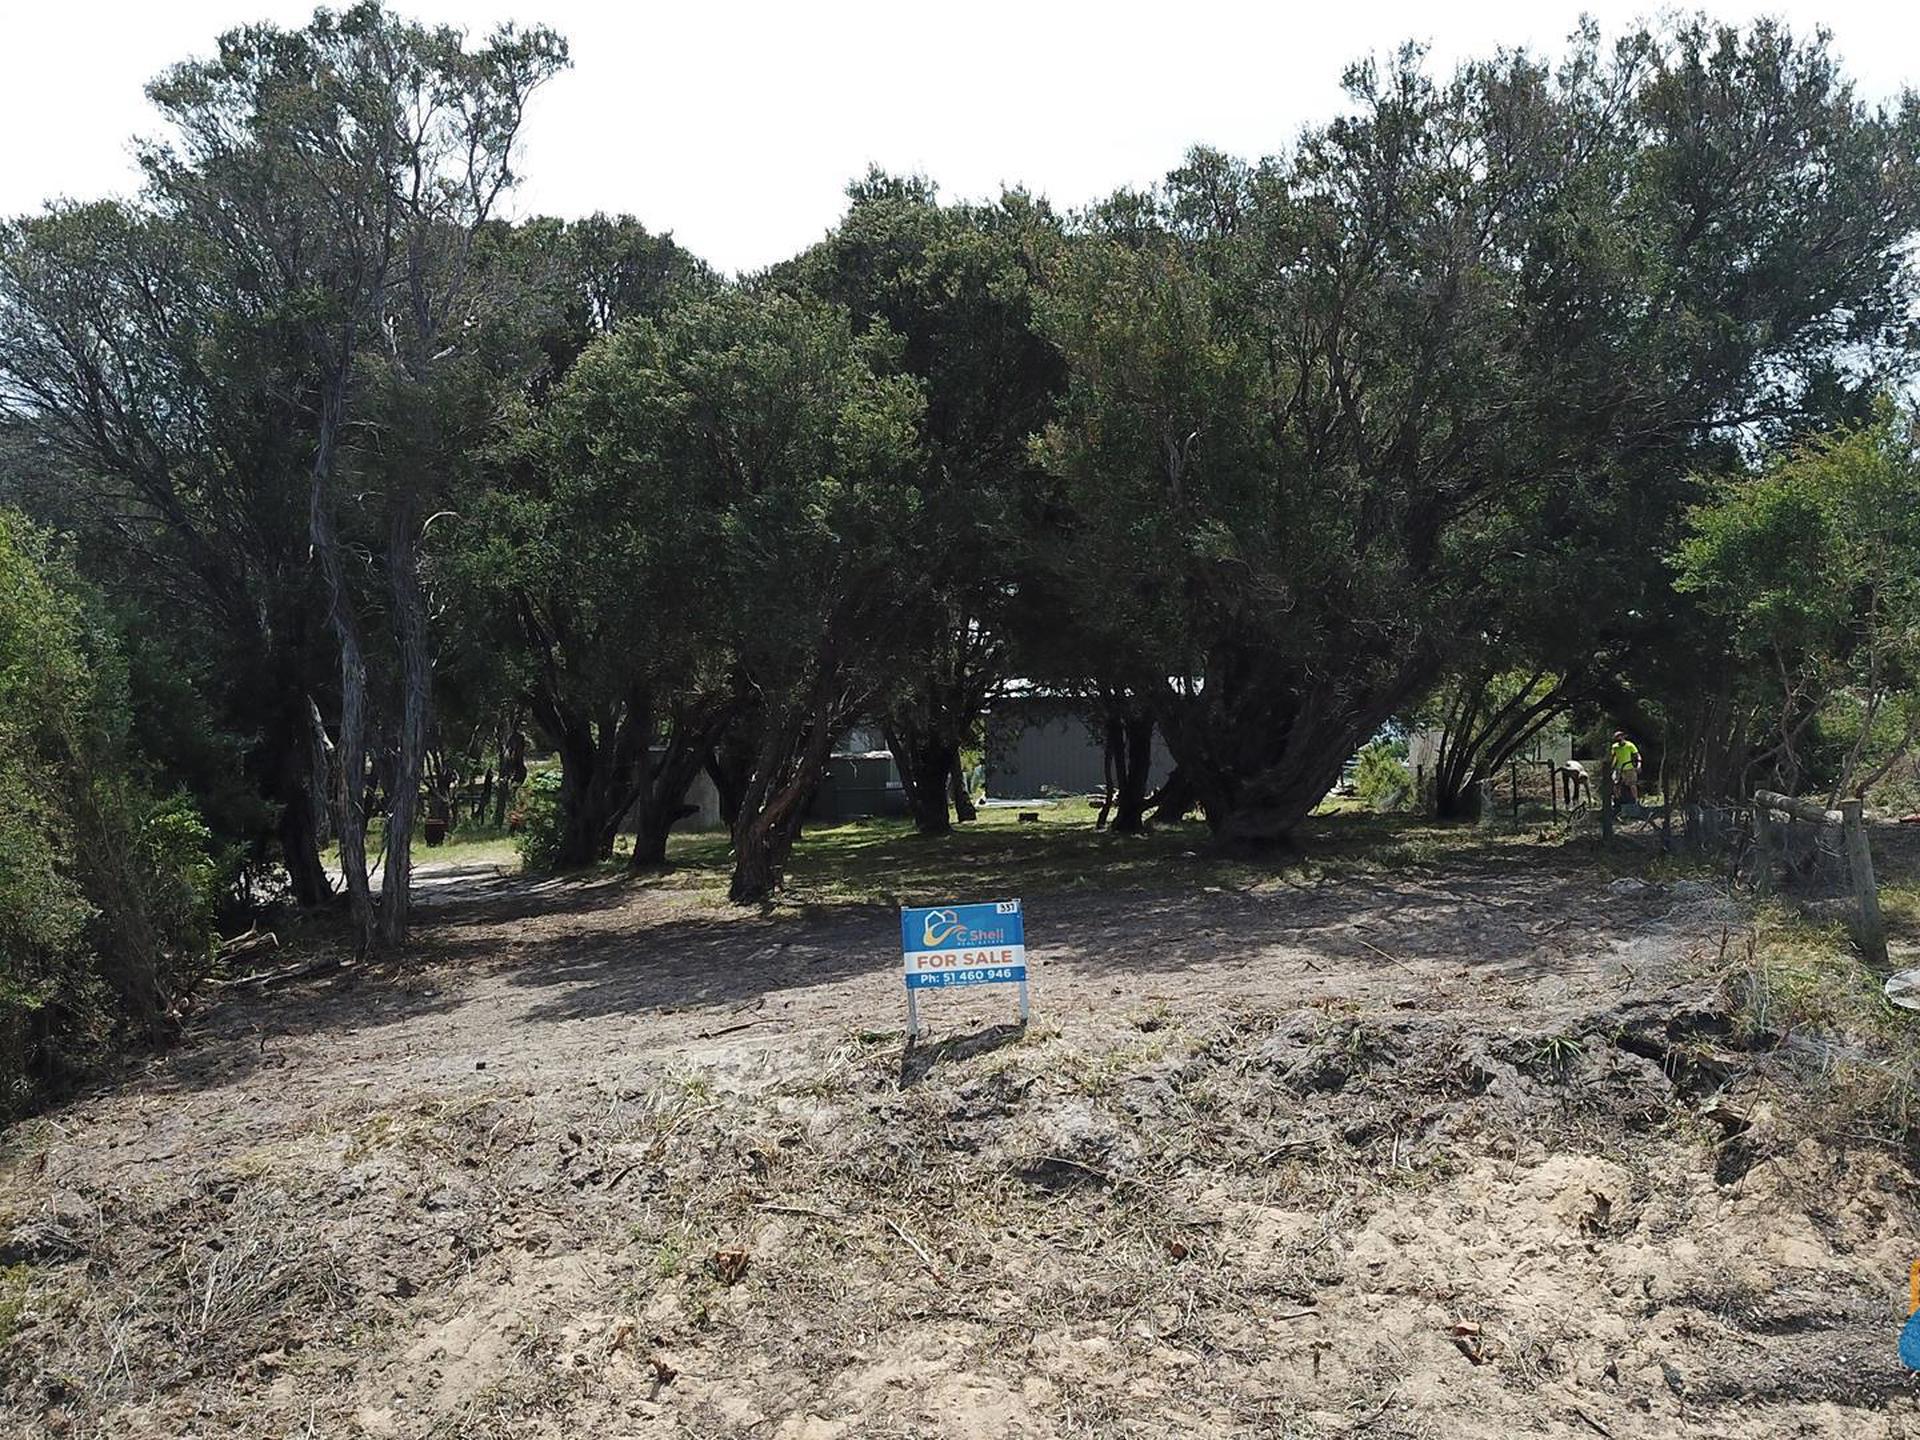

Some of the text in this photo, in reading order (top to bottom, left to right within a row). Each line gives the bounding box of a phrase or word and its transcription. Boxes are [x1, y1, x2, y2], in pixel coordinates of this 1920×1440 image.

[956, 928, 1004, 941] C Shell
[917, 950, 1013, 968] FOR SALE
[920, 974, 940, 984] Ph:
[943, 972, 956, 982] 51
[959, 970, 984, 981] 460
[987, 968, 1012, 979] 946
